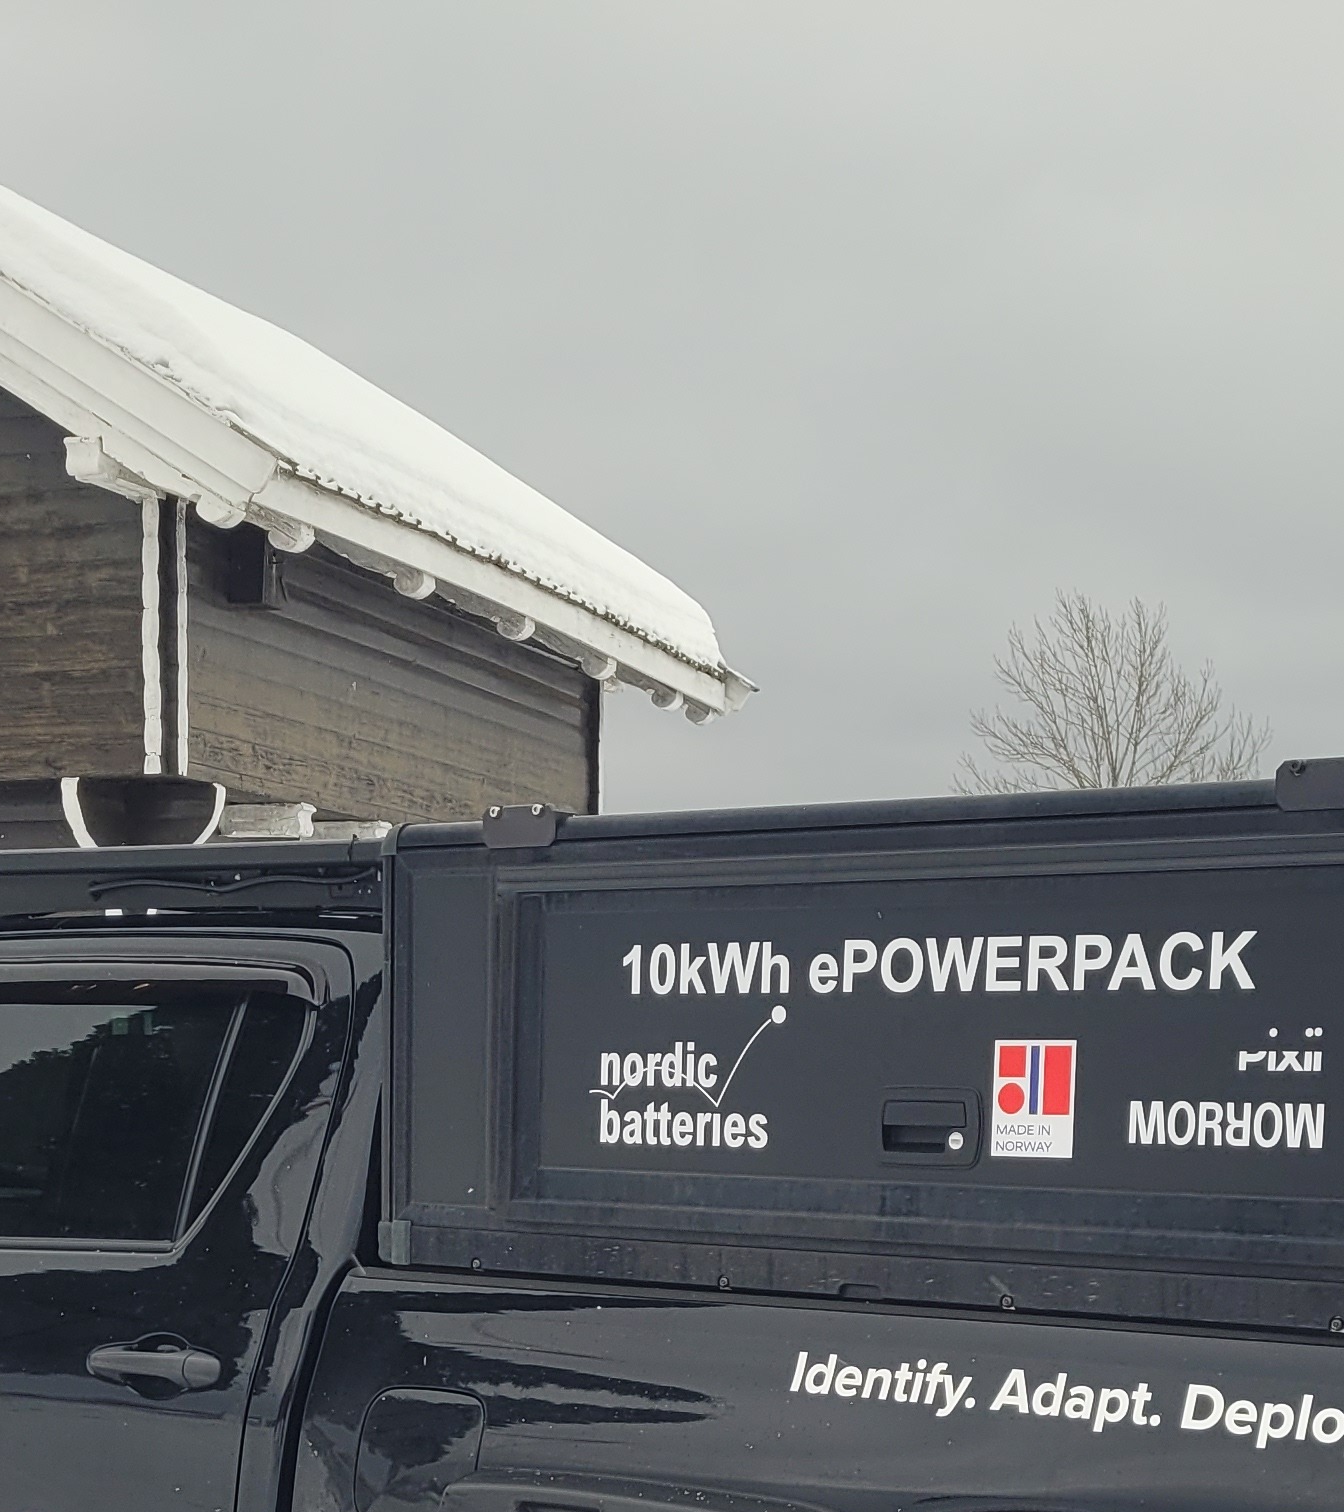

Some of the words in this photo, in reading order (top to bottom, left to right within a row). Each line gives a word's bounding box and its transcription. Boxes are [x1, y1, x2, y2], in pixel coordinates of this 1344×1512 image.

[622, 941, 790, 996] 10kWh
[808, 930, 1258, 994] ePOWERPACK
[600, 1041, 719, 1088] nordic
[599, 1098, 769, 1149] batteries
[995, 1140, 1053, 1153] NORWAY
[996, 1124, 1034, 1136] MADE
[1038, 1125, 1051, 1136] IN
[1128, 1100, 1325, 1149] MORROW
[789, 1350, 976, 1418] Identify.
[989, 1368, 1161, 1430] Adapt.
